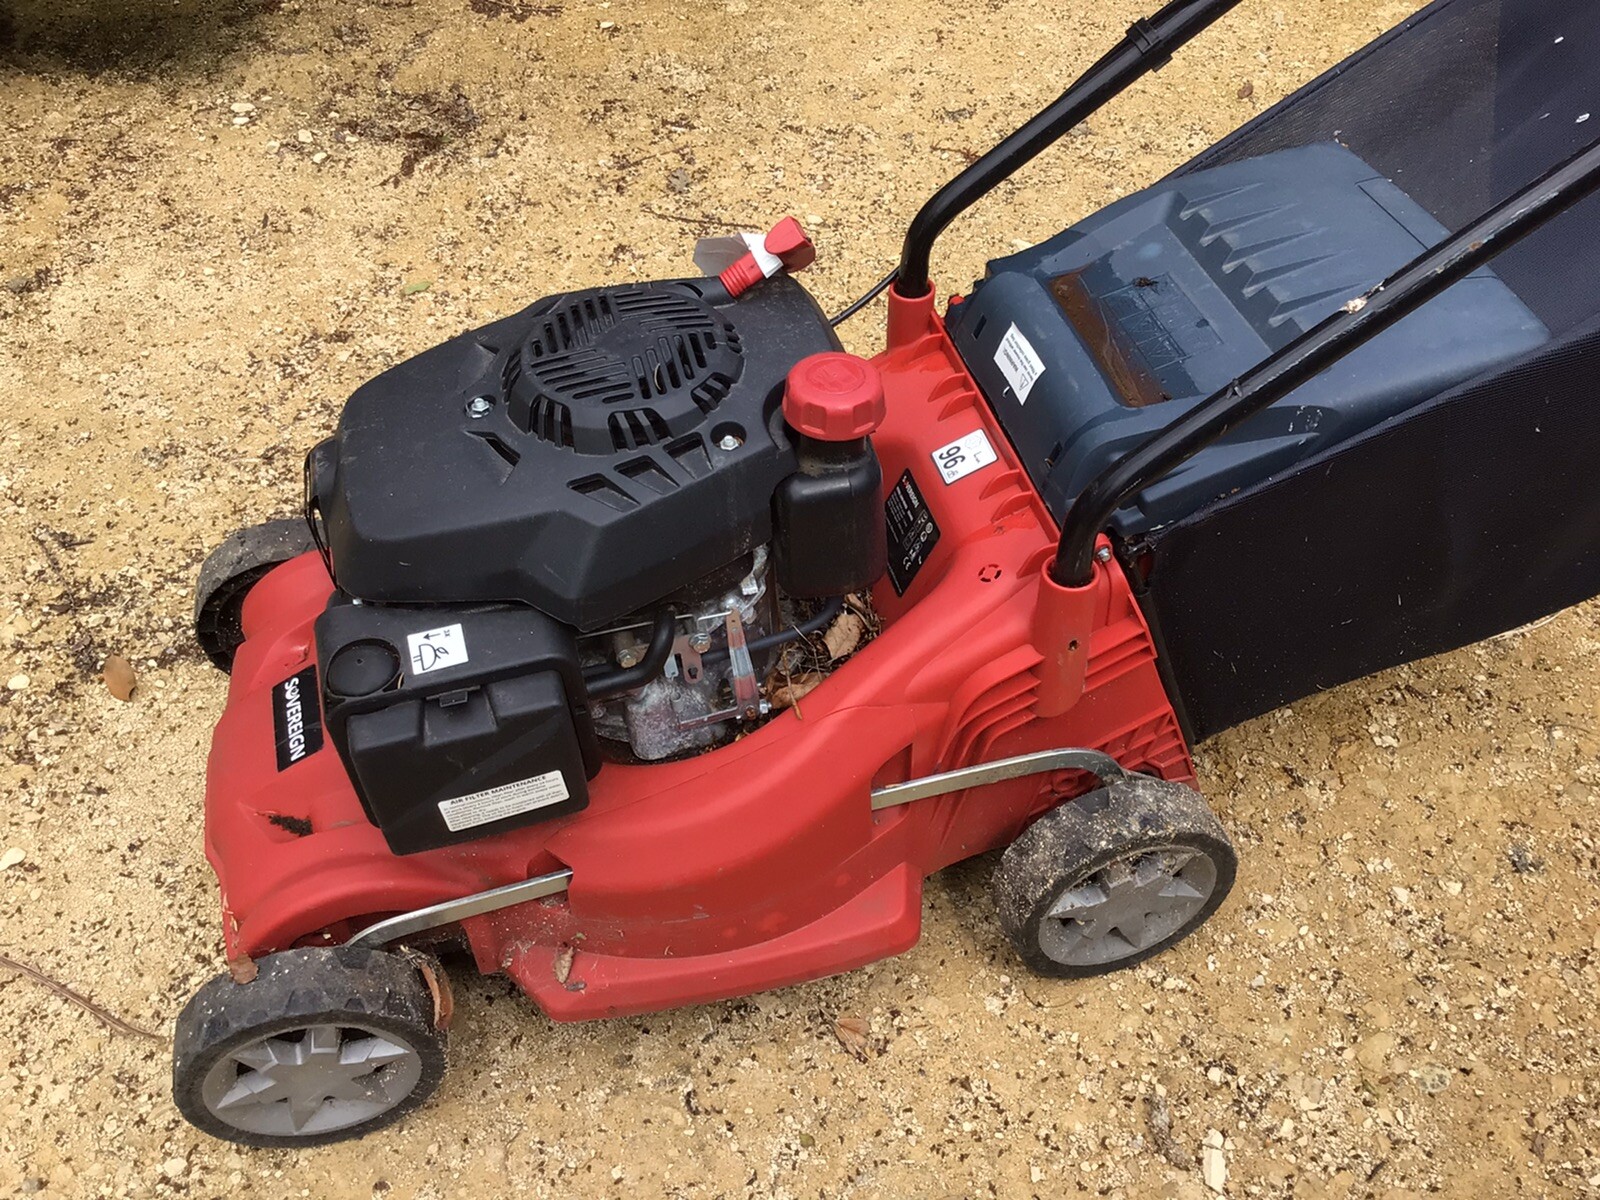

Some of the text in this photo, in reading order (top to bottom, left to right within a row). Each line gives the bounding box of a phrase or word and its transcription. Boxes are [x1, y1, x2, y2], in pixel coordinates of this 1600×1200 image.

[938, 445, 966, 469] 96
[284, 677, 306, 762] SOVEREIGN
[450, 775, 547, 806] AIR FILTER MAINTENANCE
